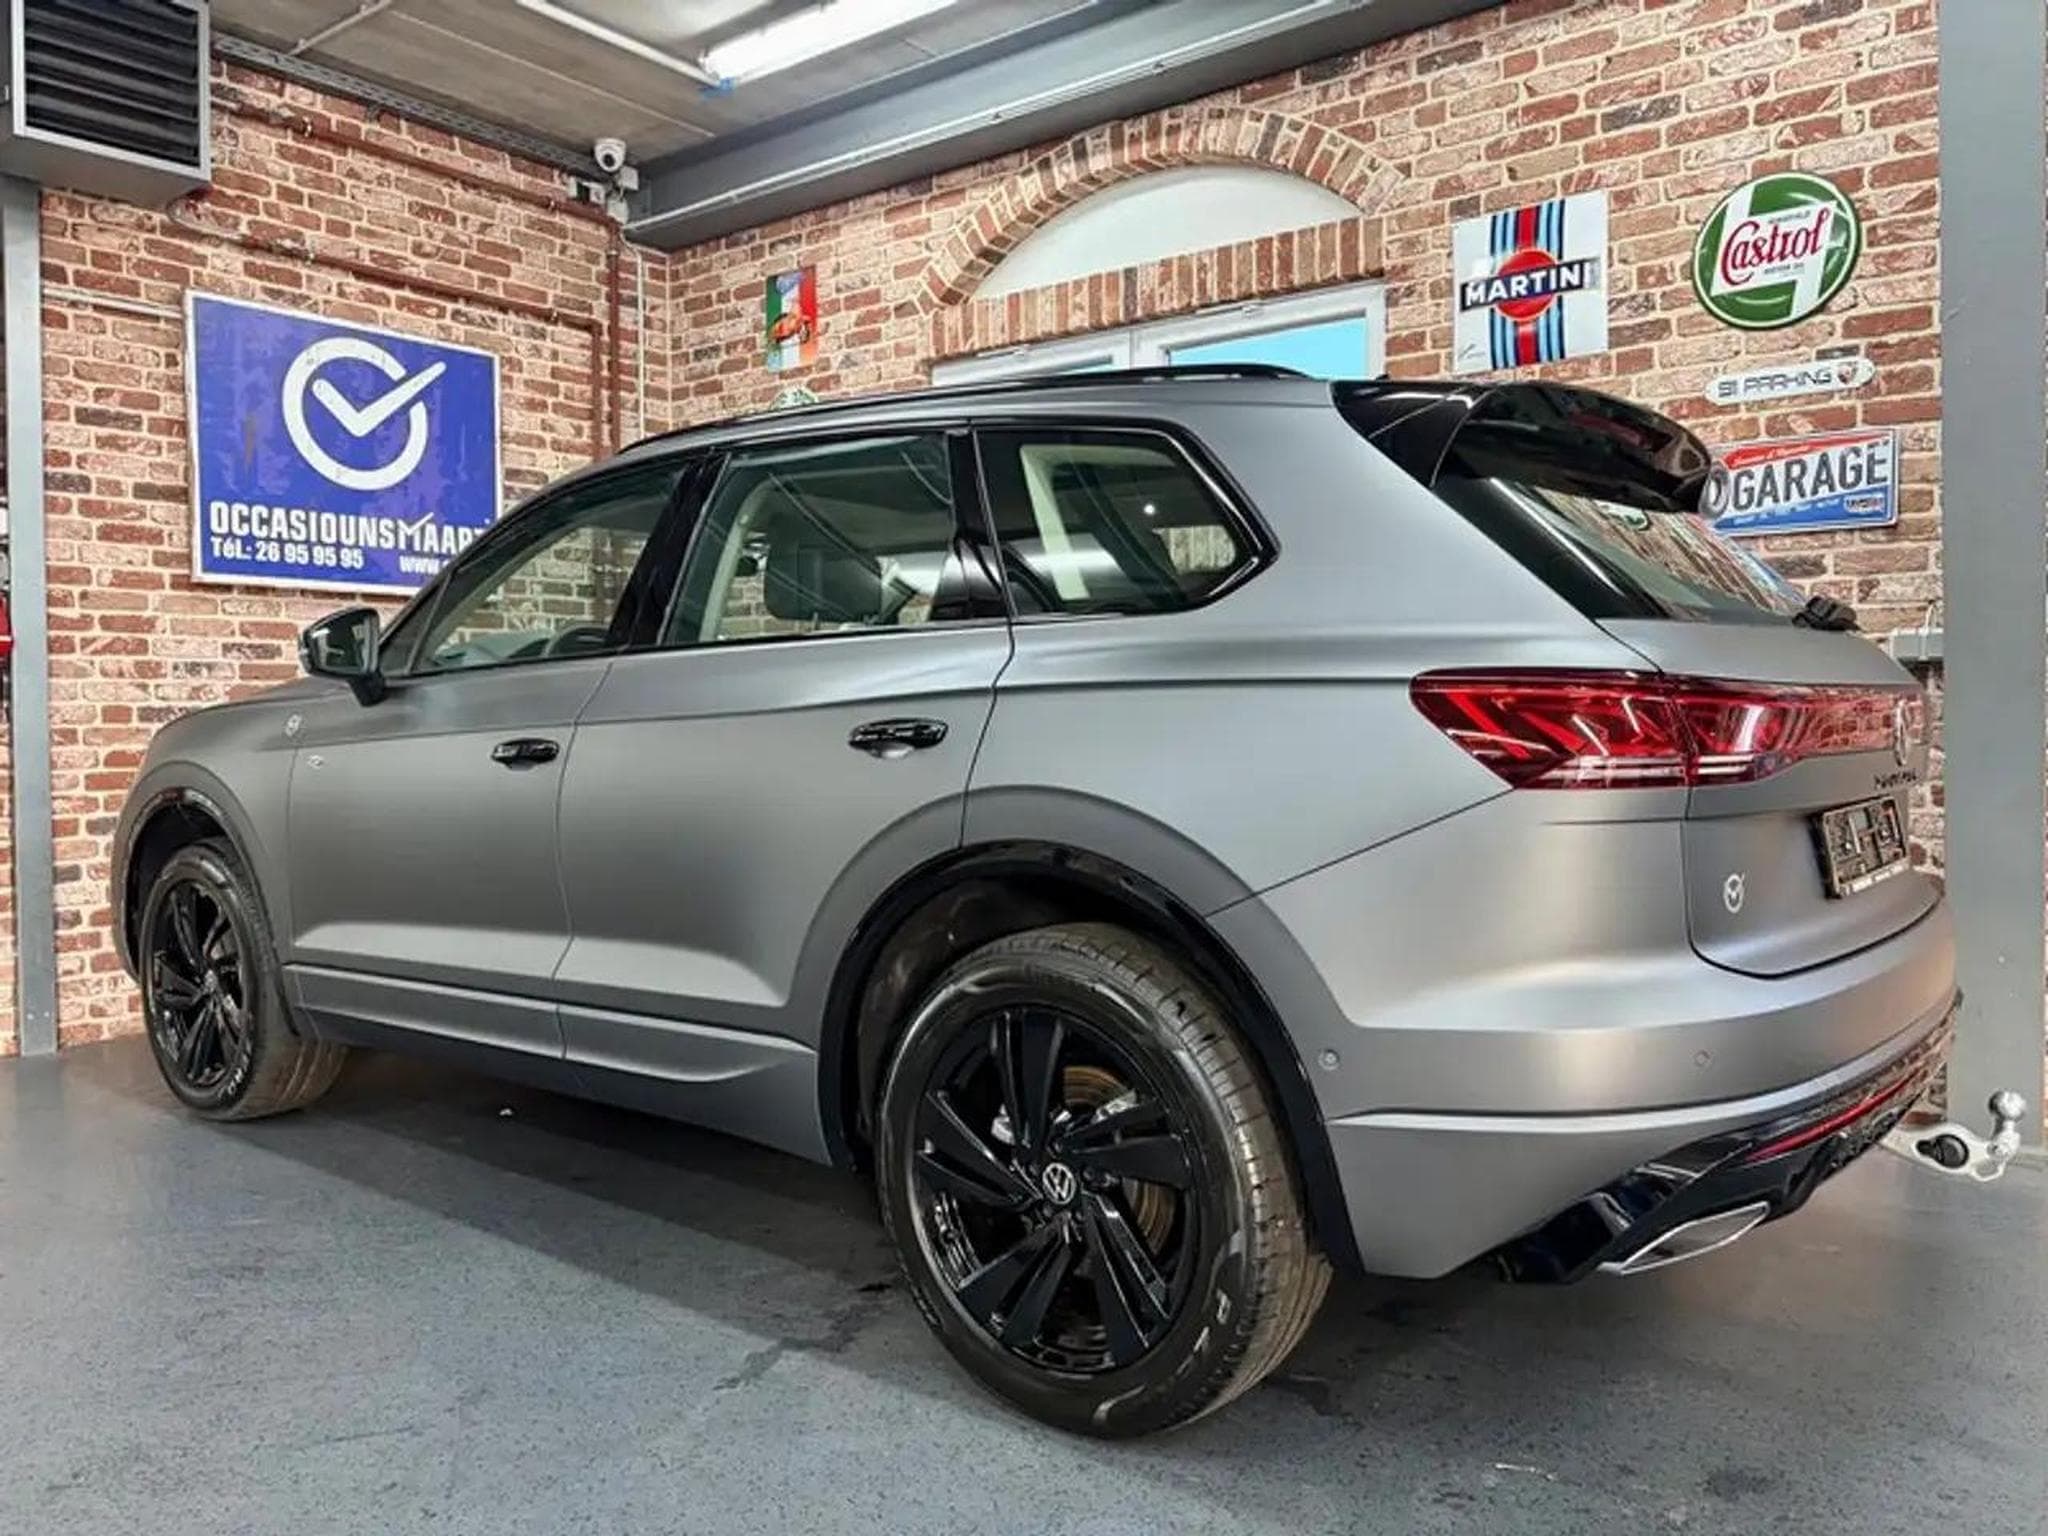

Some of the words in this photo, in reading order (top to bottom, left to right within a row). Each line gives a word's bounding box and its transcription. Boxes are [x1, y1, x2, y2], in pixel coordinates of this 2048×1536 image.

[1720, 206, 1831, 286] Castrol
[1464, 262, 1593, 307] MARTINI
[1732, 440, 1890, 512] GARAGE
[284, 543, 309, 565] 95
[312, 545, 337, 567] 95
[340, 548, 364, 570] 95
